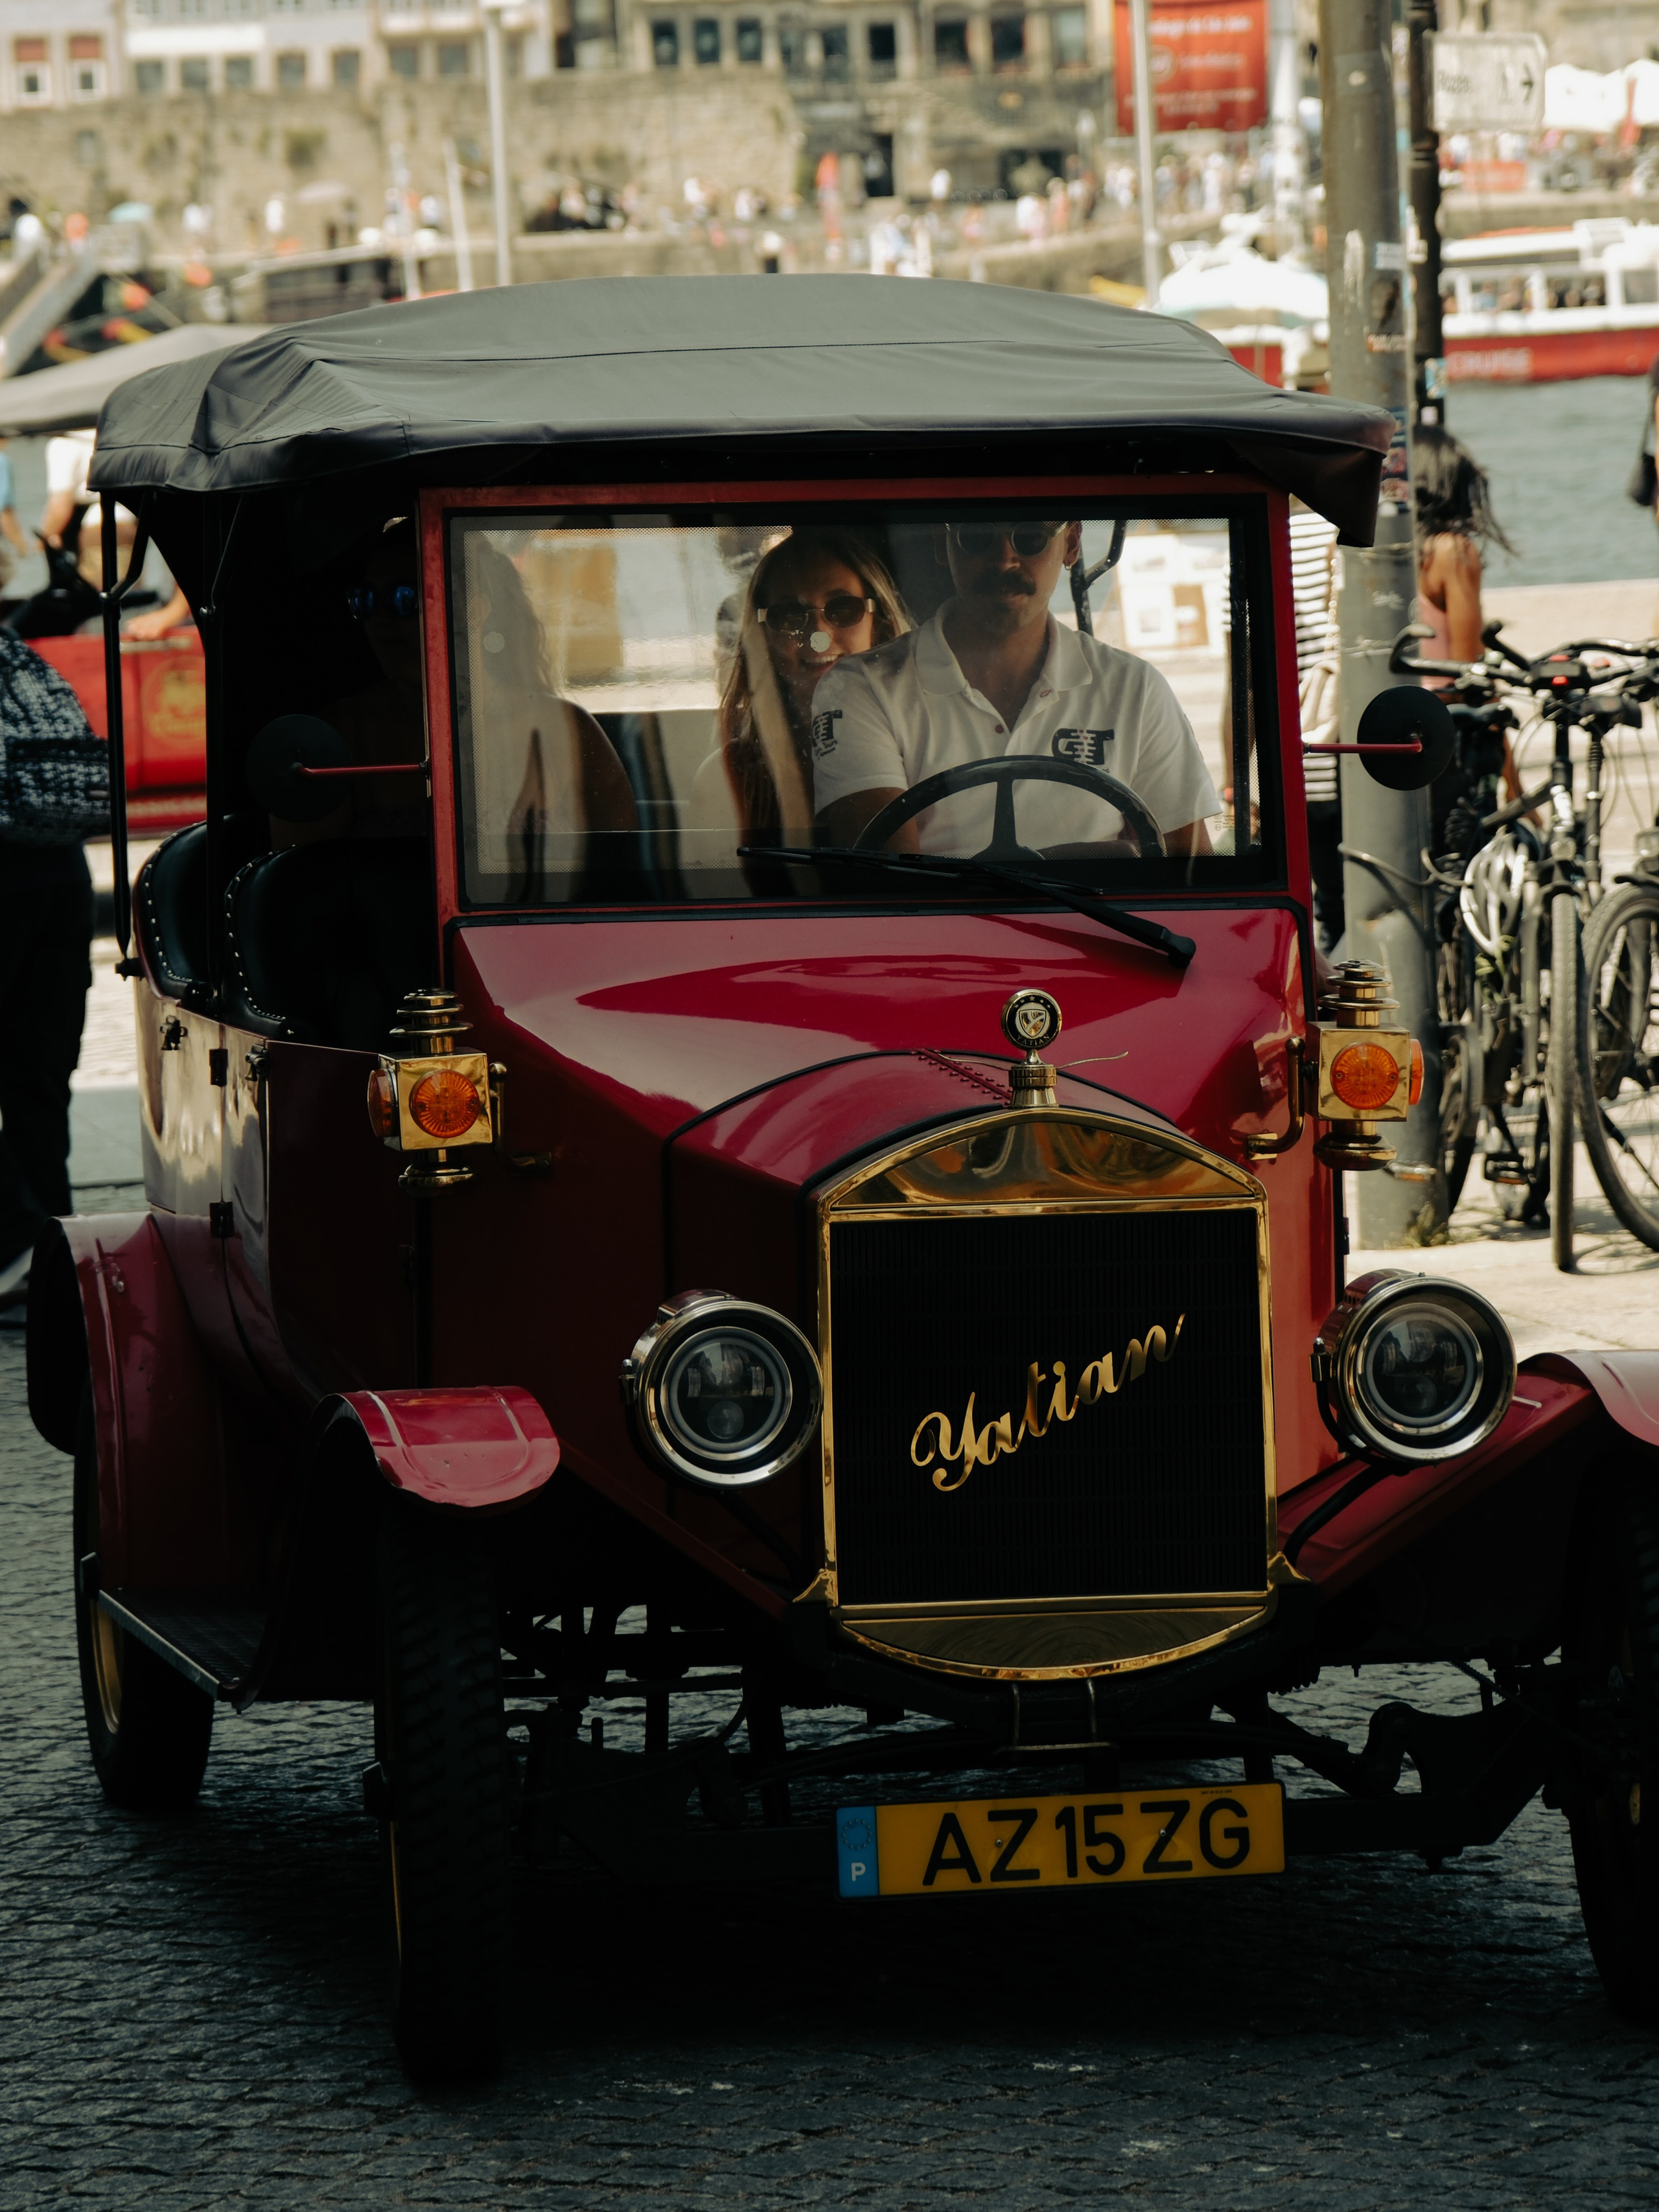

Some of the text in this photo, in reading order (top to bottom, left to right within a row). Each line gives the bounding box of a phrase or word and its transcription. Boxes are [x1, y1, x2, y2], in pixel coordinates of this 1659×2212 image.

[1016, 1034, 1050, 1046] YATIAN
[911, 1313, 1186, 1492] Yatian
[851, 1862, 866, 1882] P
